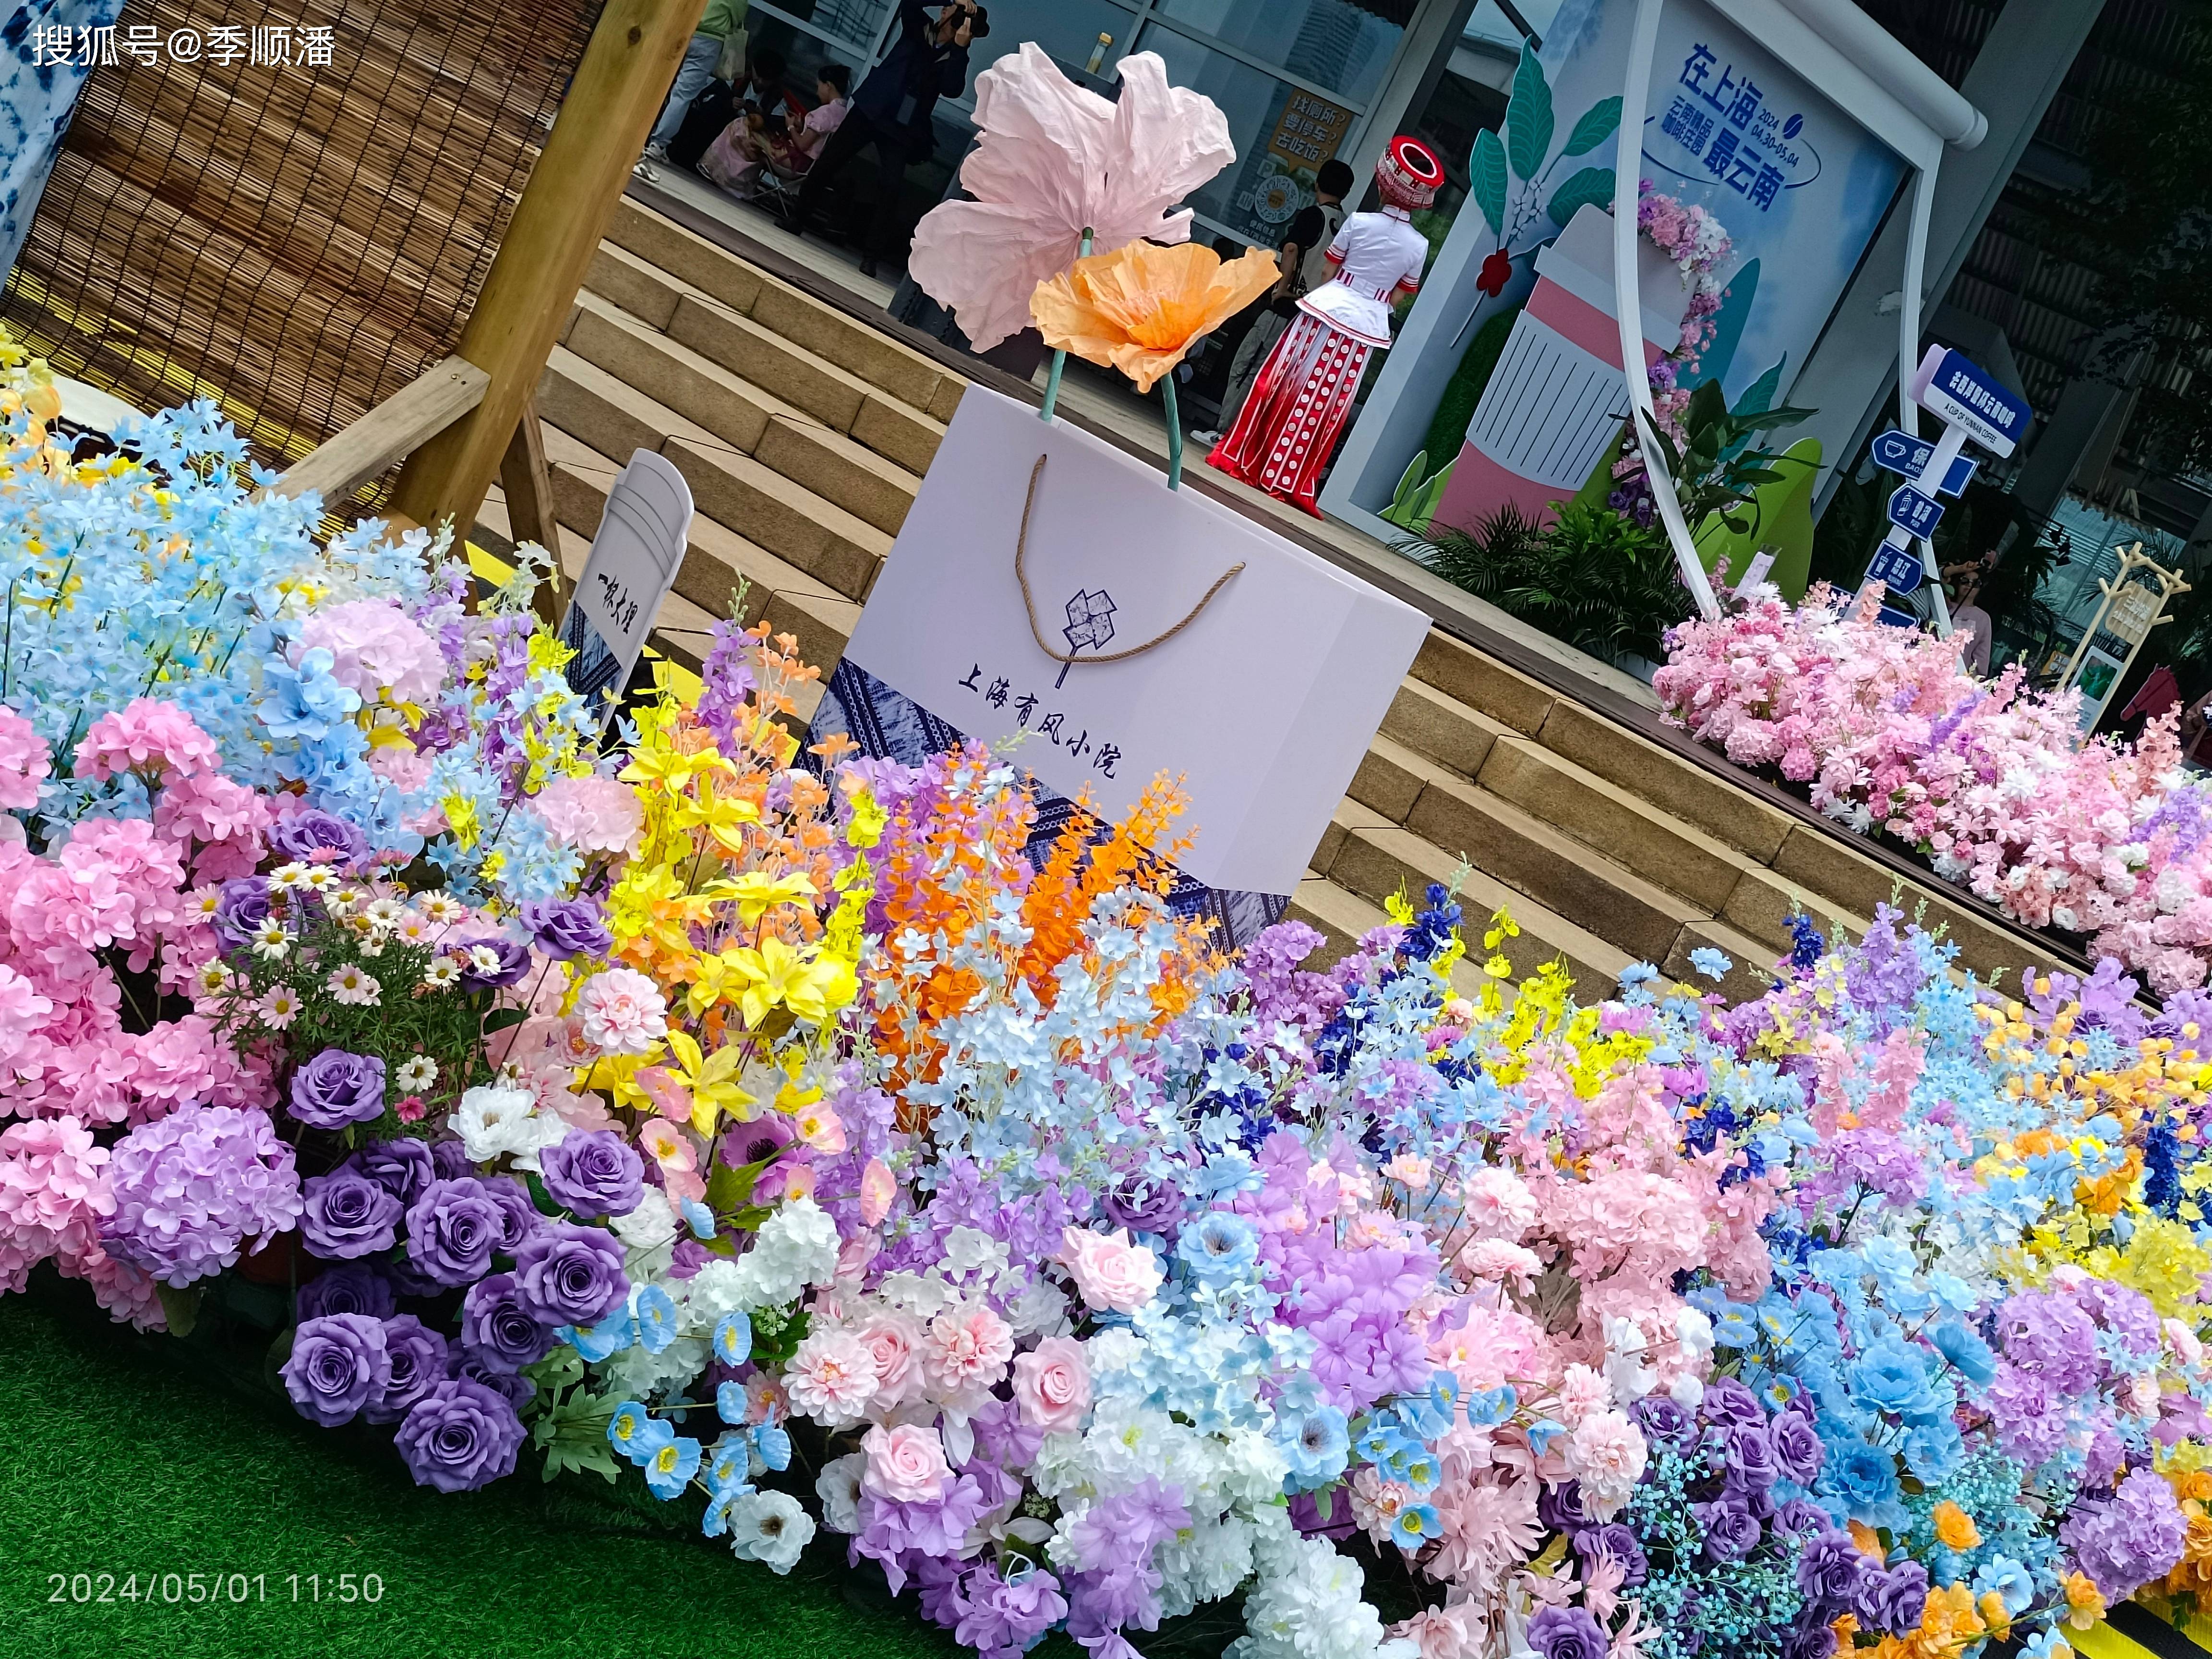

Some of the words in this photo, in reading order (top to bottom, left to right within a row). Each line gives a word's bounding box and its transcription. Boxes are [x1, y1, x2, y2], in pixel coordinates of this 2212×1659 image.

[1679, 42, 1763, 130] 在上海
[1661, 113, 1706, 156] 咖啡庄园
[1669, 95, 1715, 138] 云南精品
[1758, 108, 1780, 130] 2024
[1751, 124, 1800, 168] 04.30-05.04
[1702, 127, 1785, 212] 最云南
[1944, 403, 1949, 411] A
[1957, 412, 1965, 421] OF
[1981, 429, 1997, 444] COFFEE
[1905, 462, 1924, 474] BAOS
[1911, 447, 1930, 467] 保
[598, 574, 637, 635] 一杯大理
[959, 663, 1121, 780] 上海有风小院
